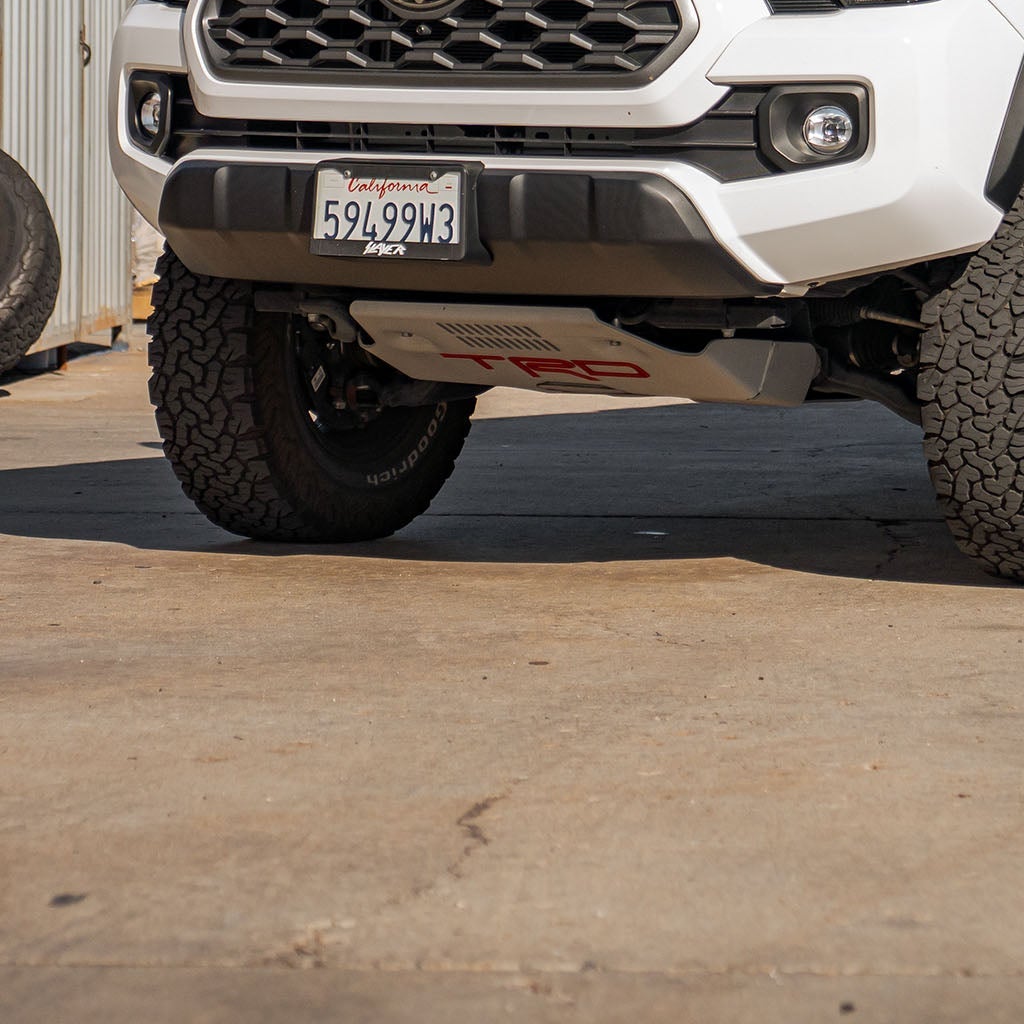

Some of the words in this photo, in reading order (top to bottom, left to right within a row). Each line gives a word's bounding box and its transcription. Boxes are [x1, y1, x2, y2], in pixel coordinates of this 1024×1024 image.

[348, 177, 439, 199] California
[324, 200, 454, 243] 59499W3
[363, 241, 407, 256] SLAYER
[440, 353, 650, 381] TRD
